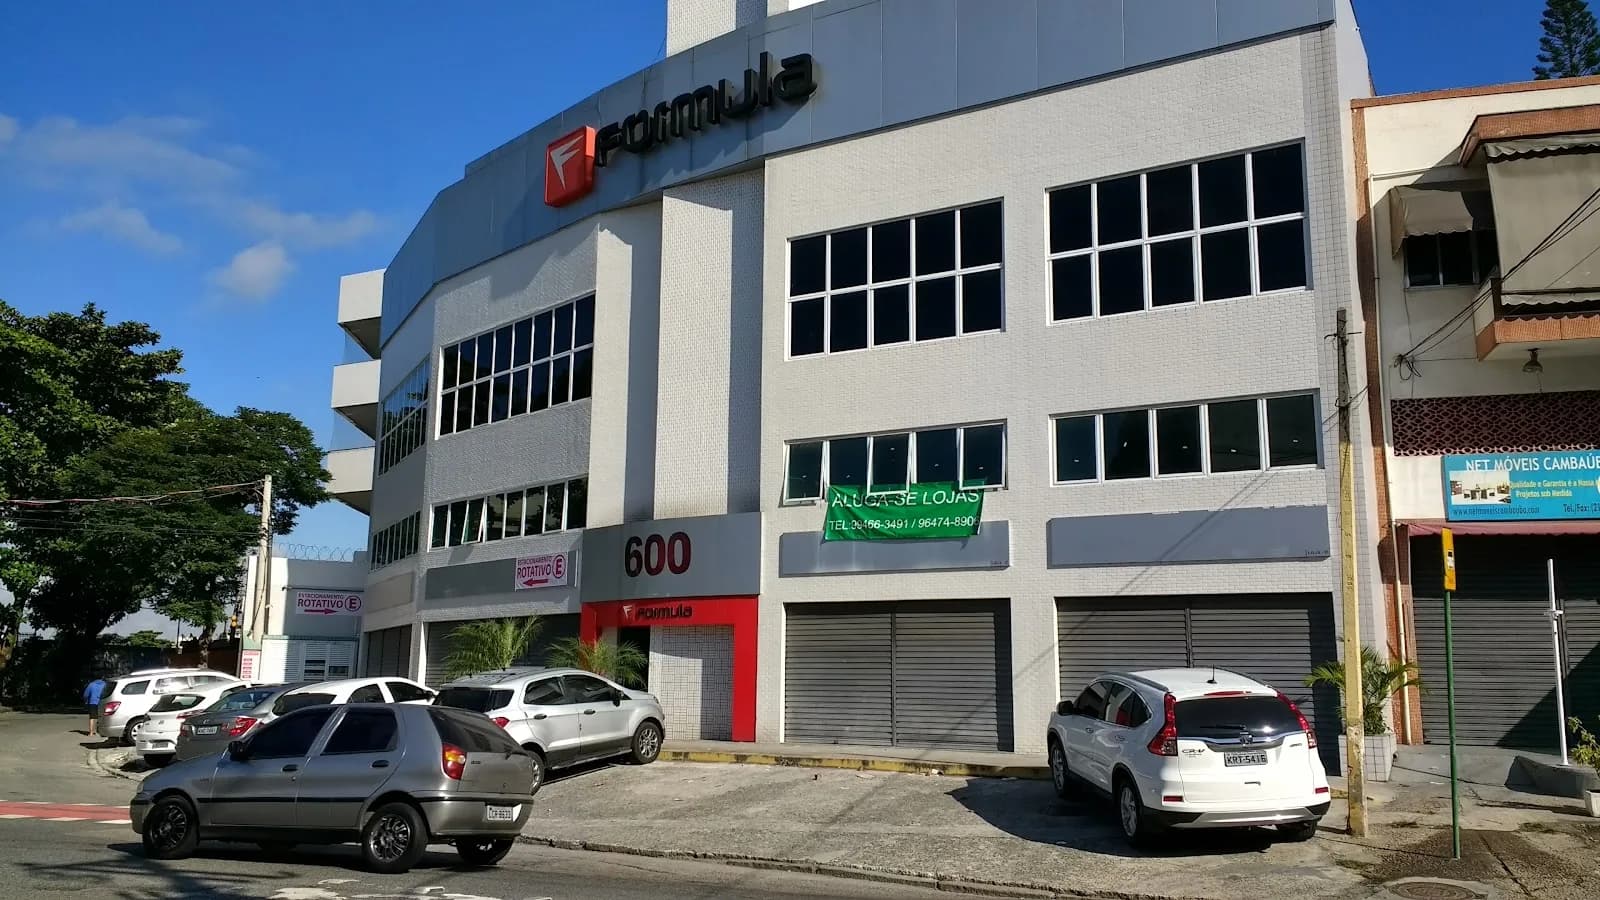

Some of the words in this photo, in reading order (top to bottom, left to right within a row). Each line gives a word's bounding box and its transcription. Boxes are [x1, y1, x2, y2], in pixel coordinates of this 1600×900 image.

[1465, 460, 1491, 471] NET
[1494, 456, 1540, 471] MÓVEIS
[831, 490, 918, 508] ALUGA-SE
[922, 490, 980, 506] LOJAS
[624, 530, 692, 578] 600
[517, 564, 552, 579] ROTATIVO
[297, 599, 344, 609] ROTATIVO
[1226, 754, 1267, 765] KRT-5416
